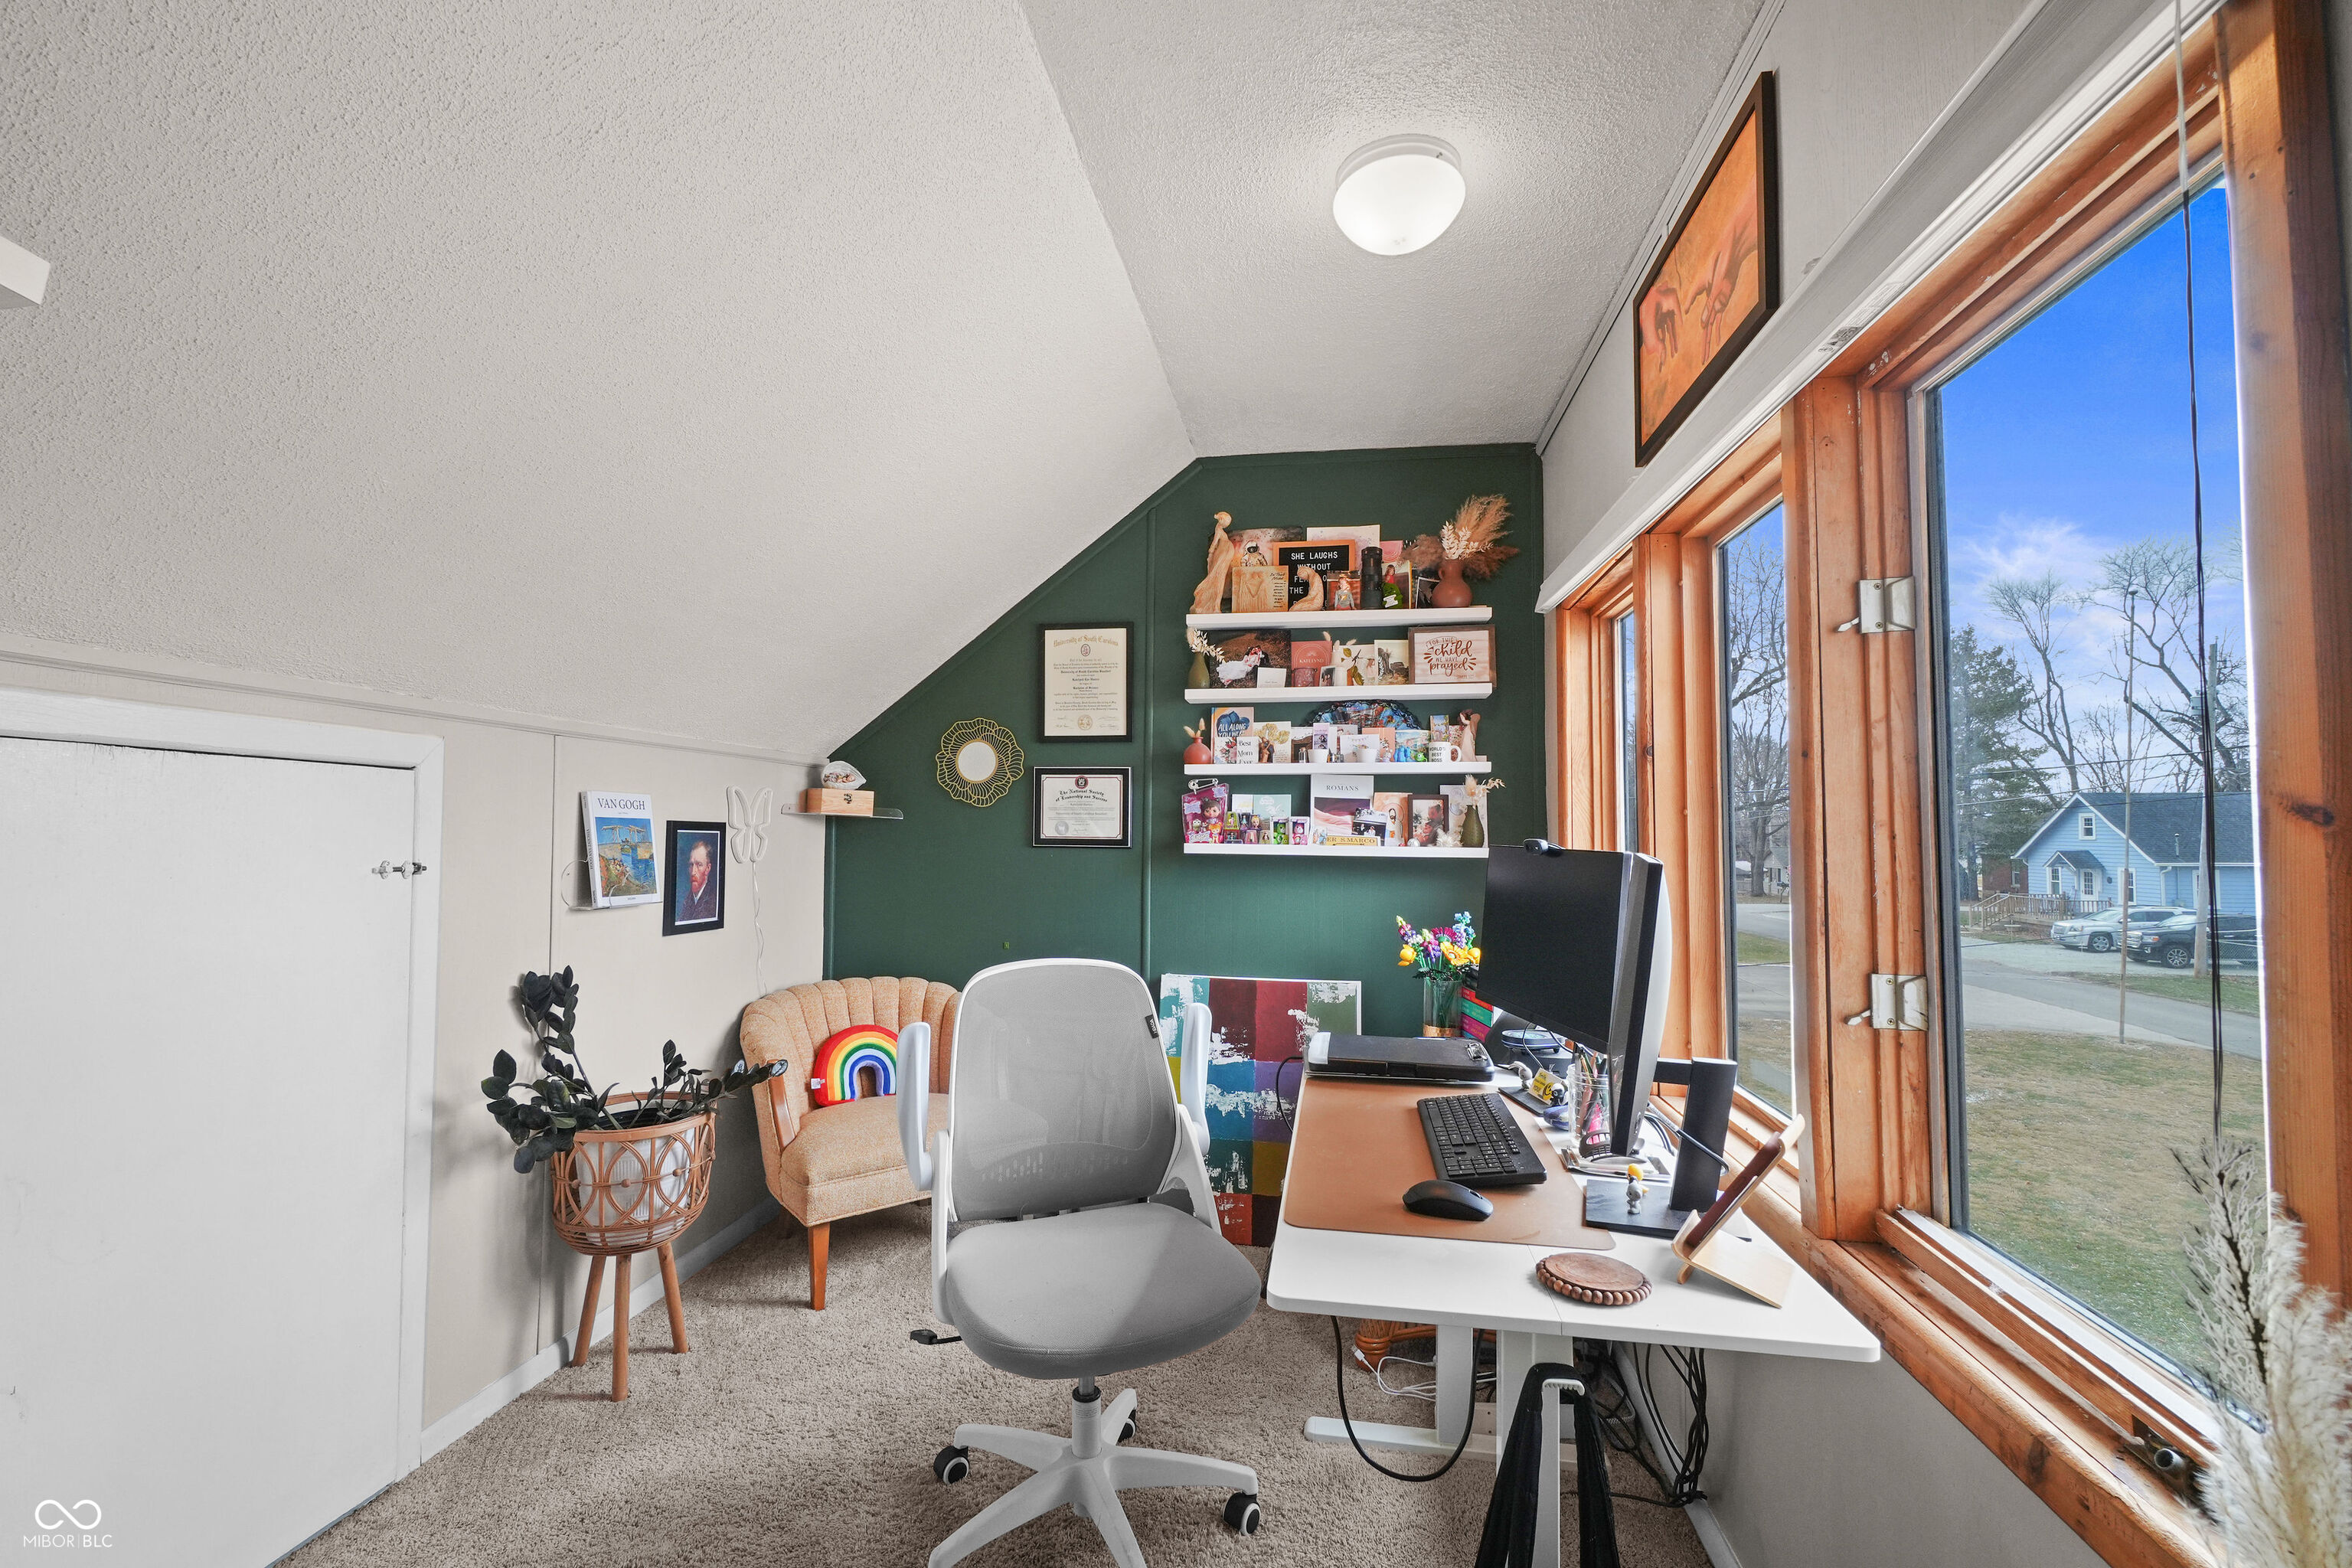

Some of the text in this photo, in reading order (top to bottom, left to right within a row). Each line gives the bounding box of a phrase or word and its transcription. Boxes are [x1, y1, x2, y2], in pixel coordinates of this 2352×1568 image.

[1291, 551, 1338, 560] SHE LAUGHS
[1434, 640, 1473, 657] child
[1429, 657, 1468, 677] prayed
[1218, 724, 1228, 732] ALL
[598, 798, 617, 809] VAN
[619, 799, 646, 810] GOGH
